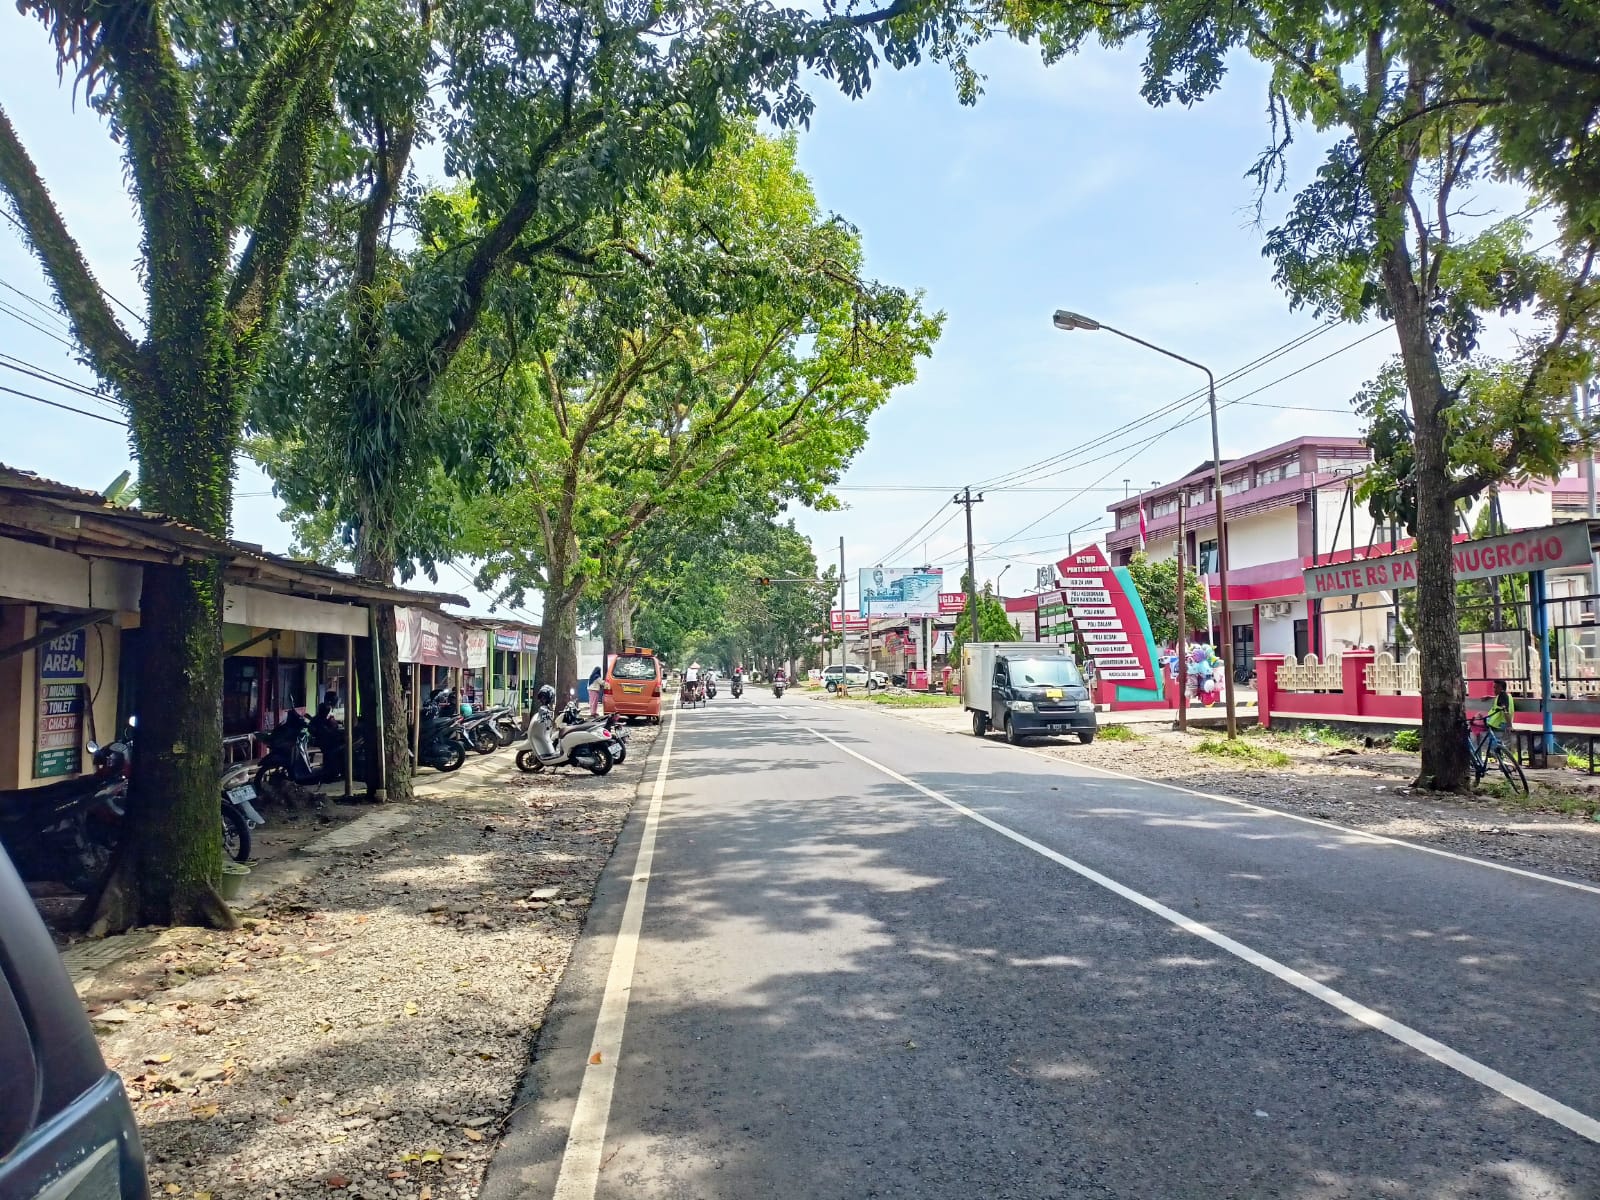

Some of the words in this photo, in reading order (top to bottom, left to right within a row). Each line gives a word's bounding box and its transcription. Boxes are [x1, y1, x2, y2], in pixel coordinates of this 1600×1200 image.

[1315, 569, 1363, 592] HALTE
[1366, 564, 1388, 585] RS
[50, 634, 79, 651] REST
[43, 653, 76, 671] AREA
[49, 701, 72, 714] TOILET
